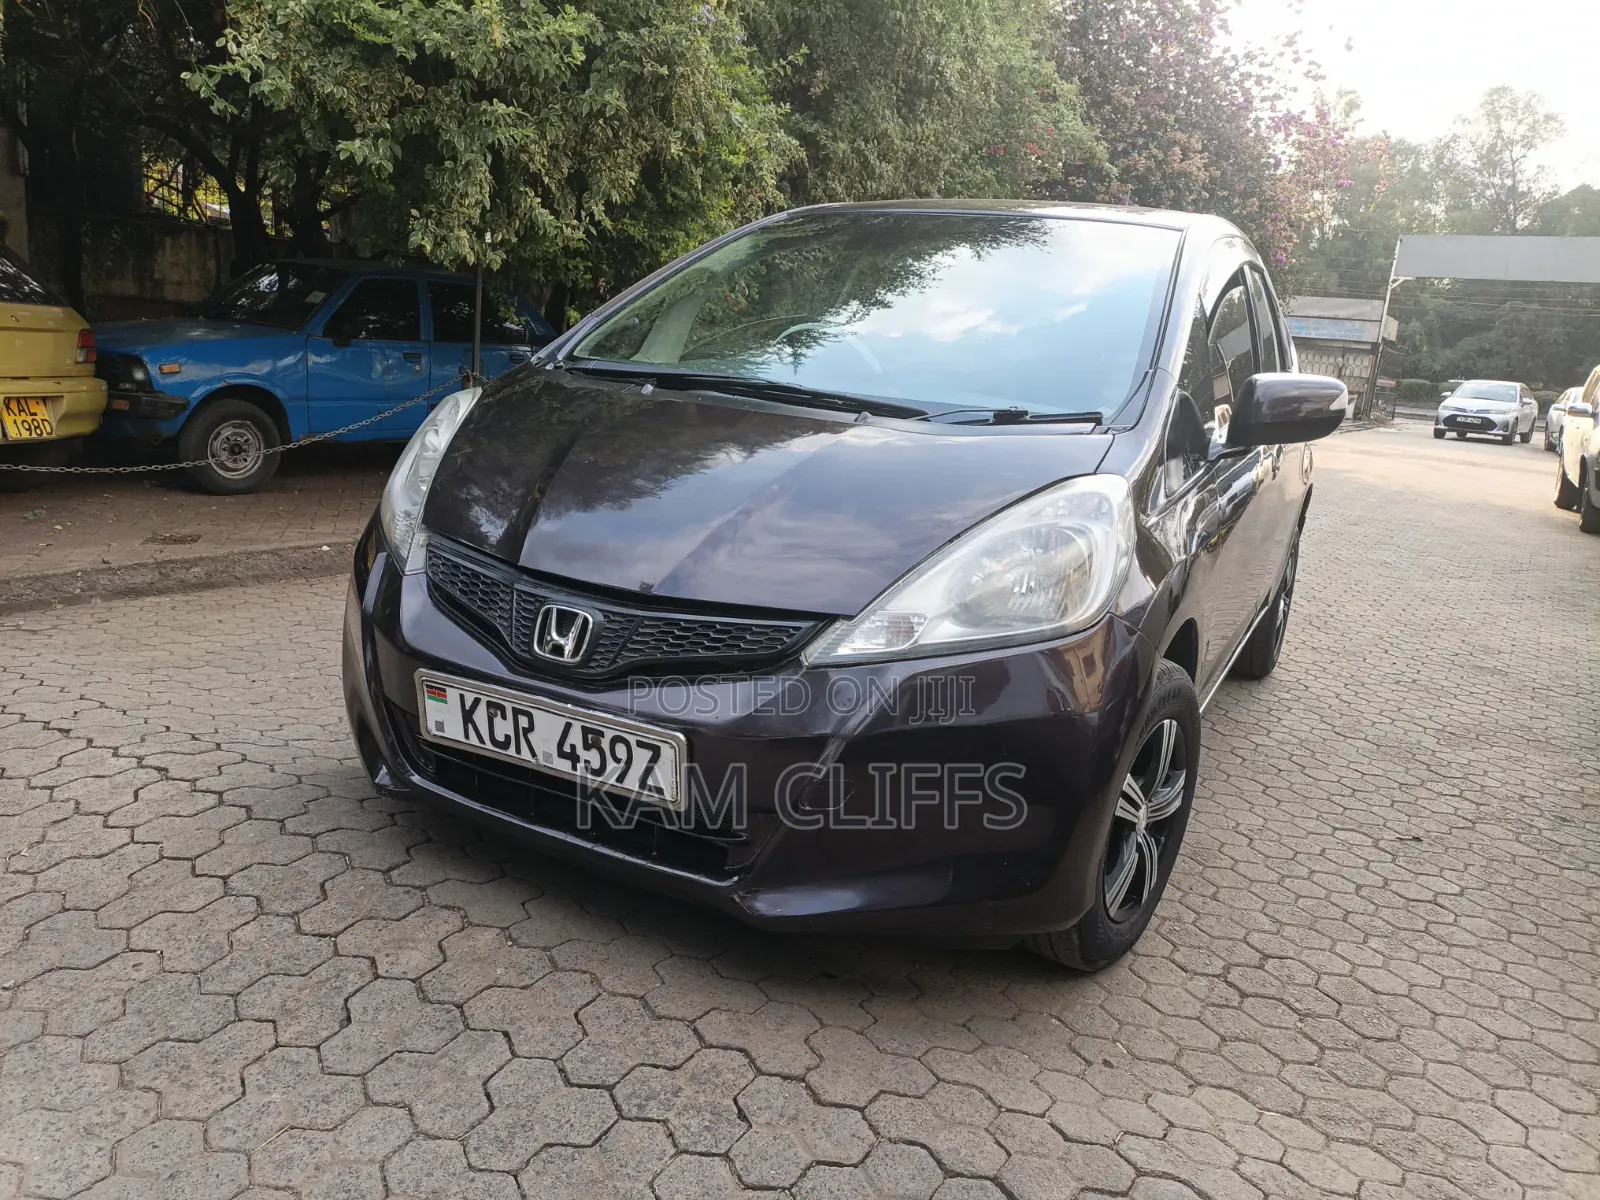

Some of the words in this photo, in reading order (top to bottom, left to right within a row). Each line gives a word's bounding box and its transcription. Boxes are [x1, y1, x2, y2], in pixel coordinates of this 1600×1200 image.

[3, 397, 38, 417] KAL
[13, 418, 53, 437] 198D
[459, 692, 538, 759] KCR
[556, 720, 665, 796] 459Z
